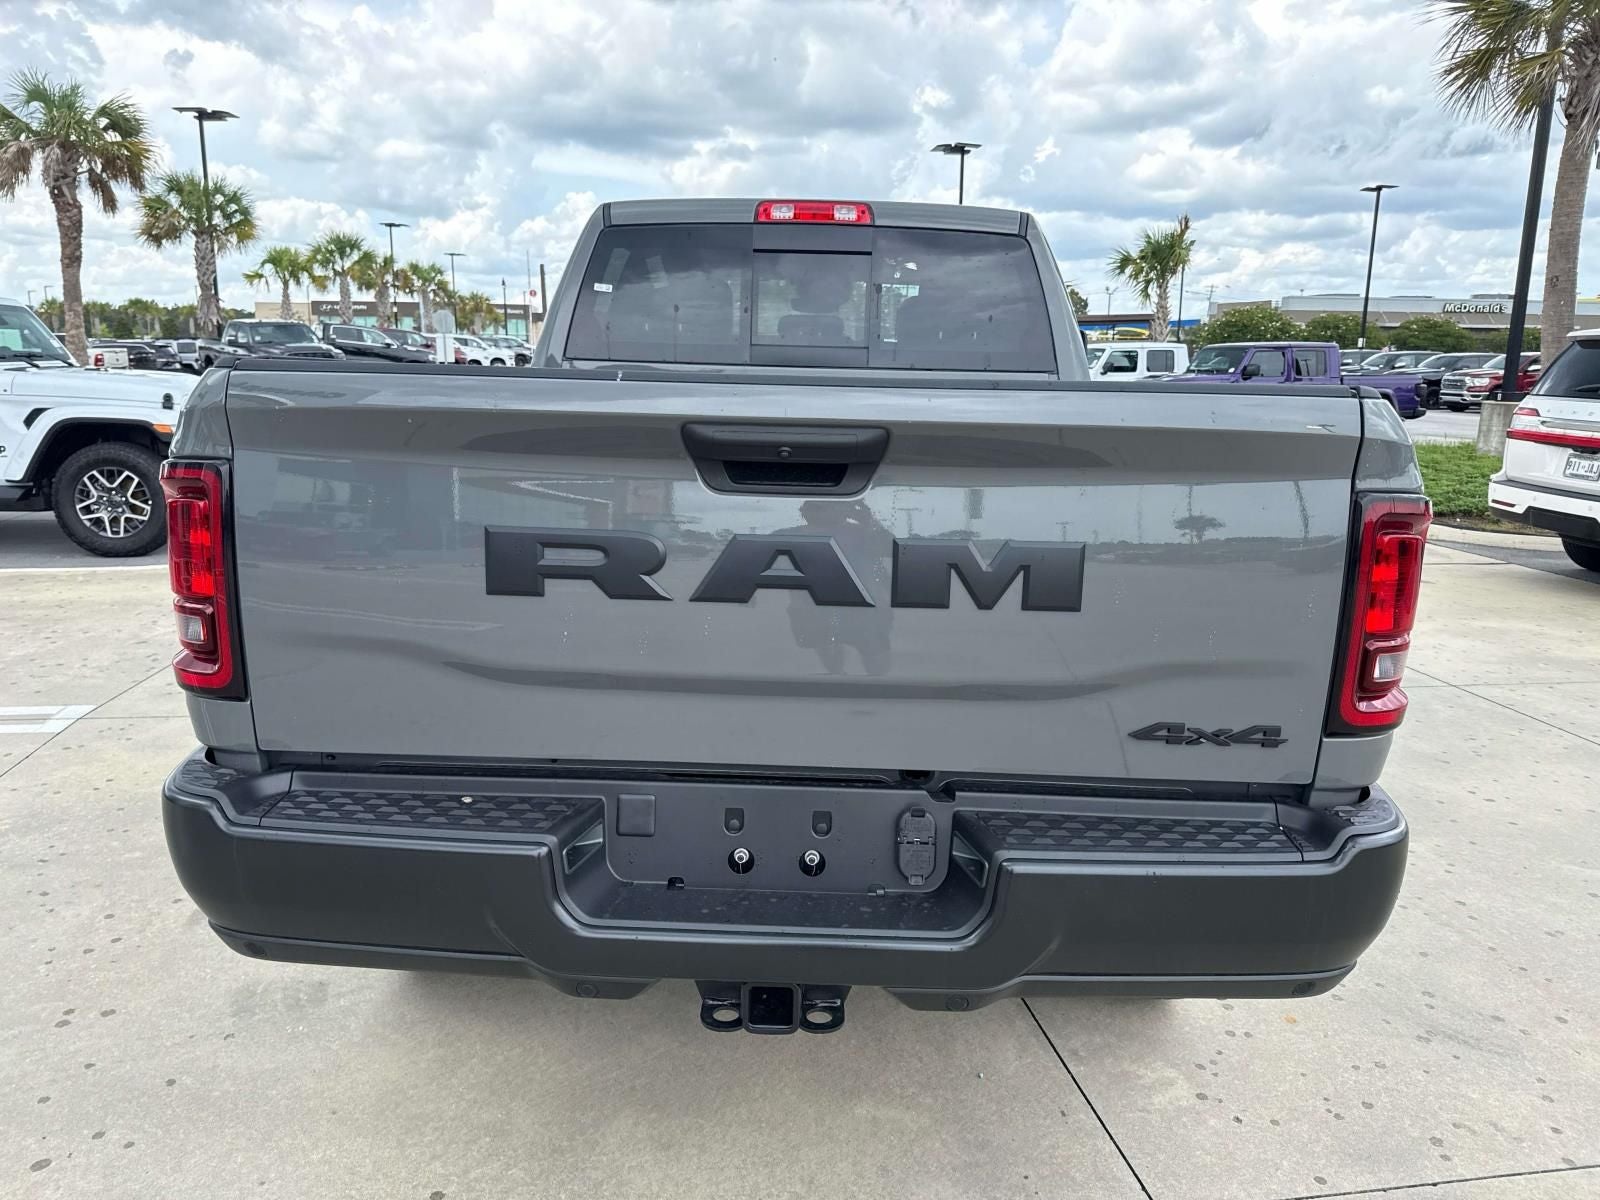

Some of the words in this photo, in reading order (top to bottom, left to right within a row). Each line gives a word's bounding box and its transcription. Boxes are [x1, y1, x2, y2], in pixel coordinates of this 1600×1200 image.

[1443, 302, 1508, 314] McDonald's
[484, 525, 1086, 612] RAM
[1128, 721, 1289, 749] 4x4
